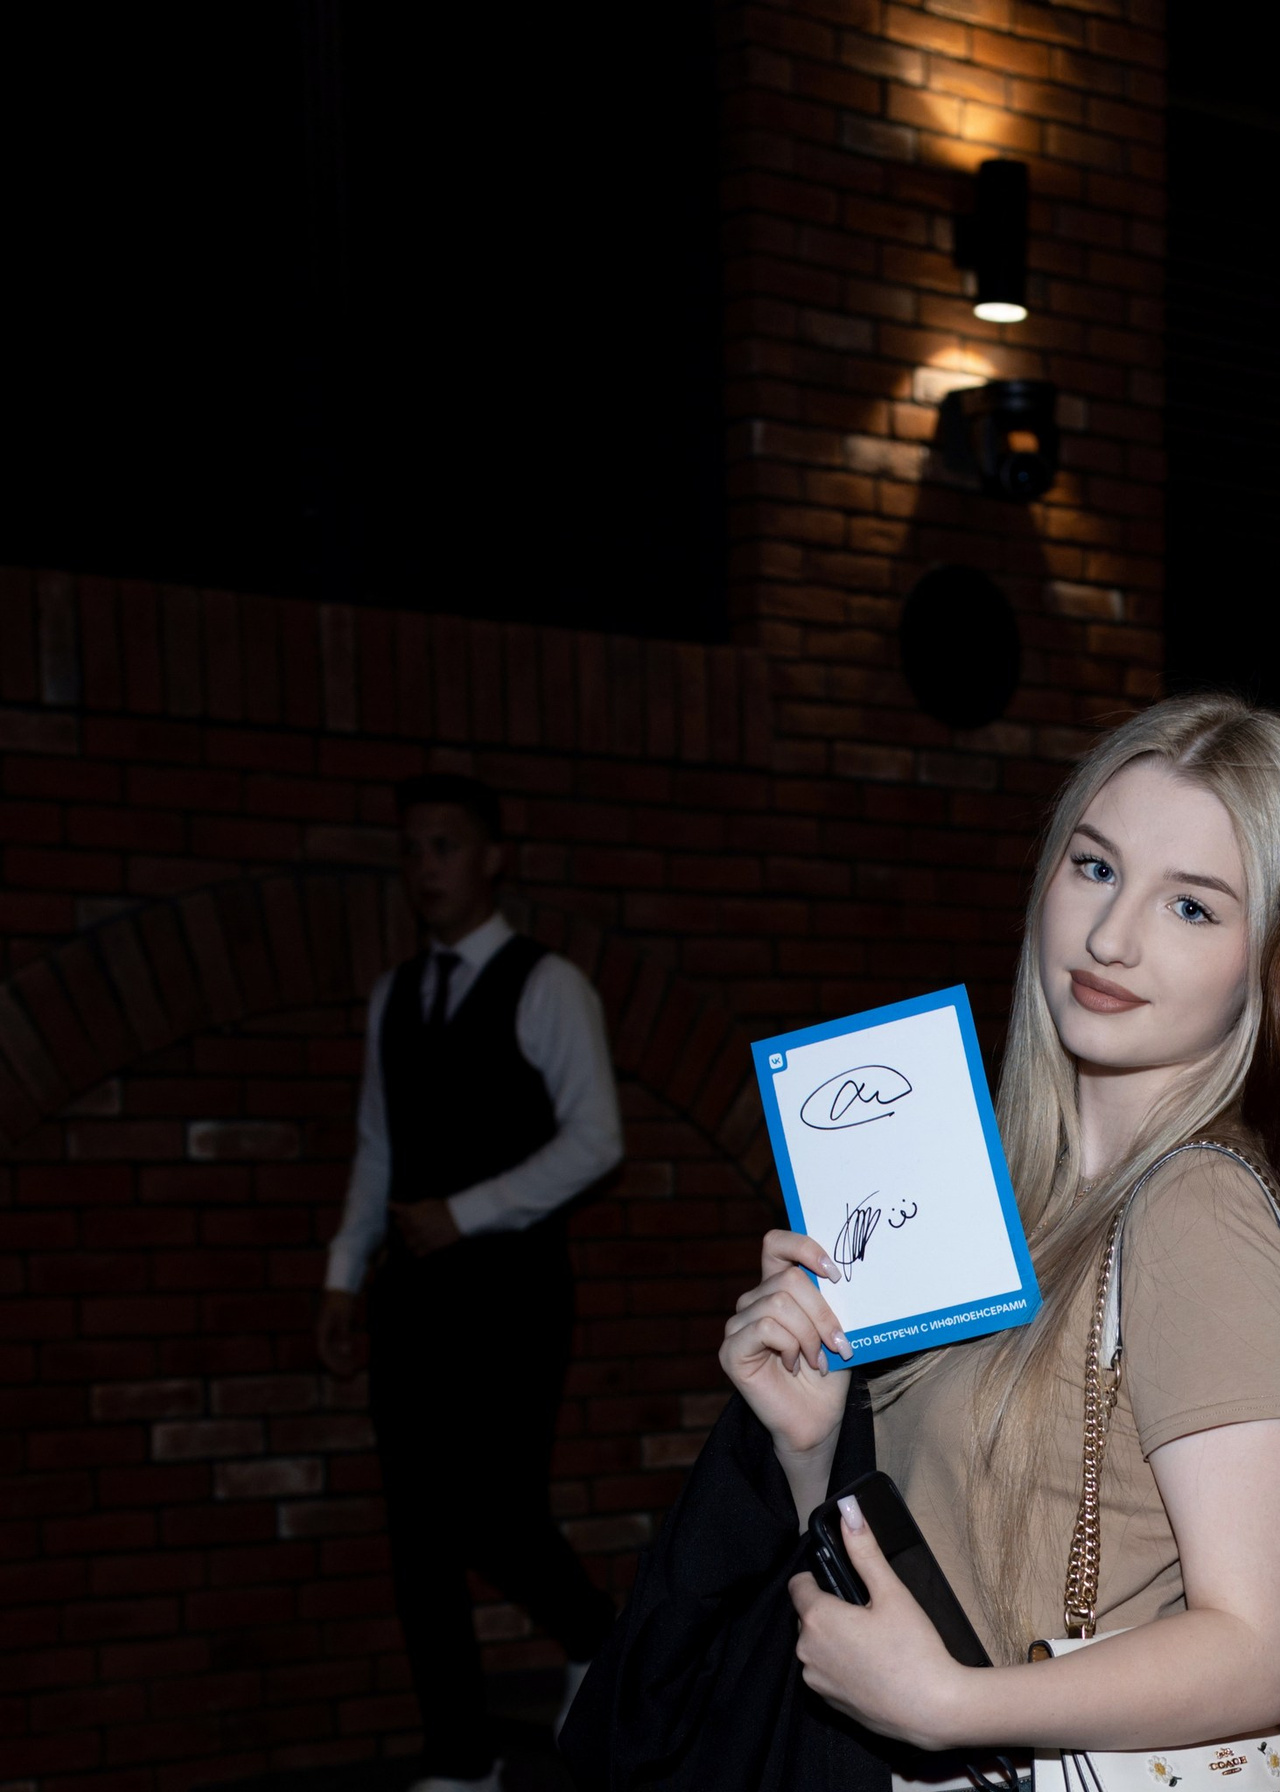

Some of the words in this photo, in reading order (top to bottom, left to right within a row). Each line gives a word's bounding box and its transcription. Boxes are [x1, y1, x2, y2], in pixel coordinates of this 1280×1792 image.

[850, 1337, 872, 1351] СТО
[873, 1325, 920, 1345] ВСТРЕЧИ
[921, 1323, 929, 1333] С
[930, 1298, 1028, 1331] ИНФЛЮЕНСЕРАМИ
